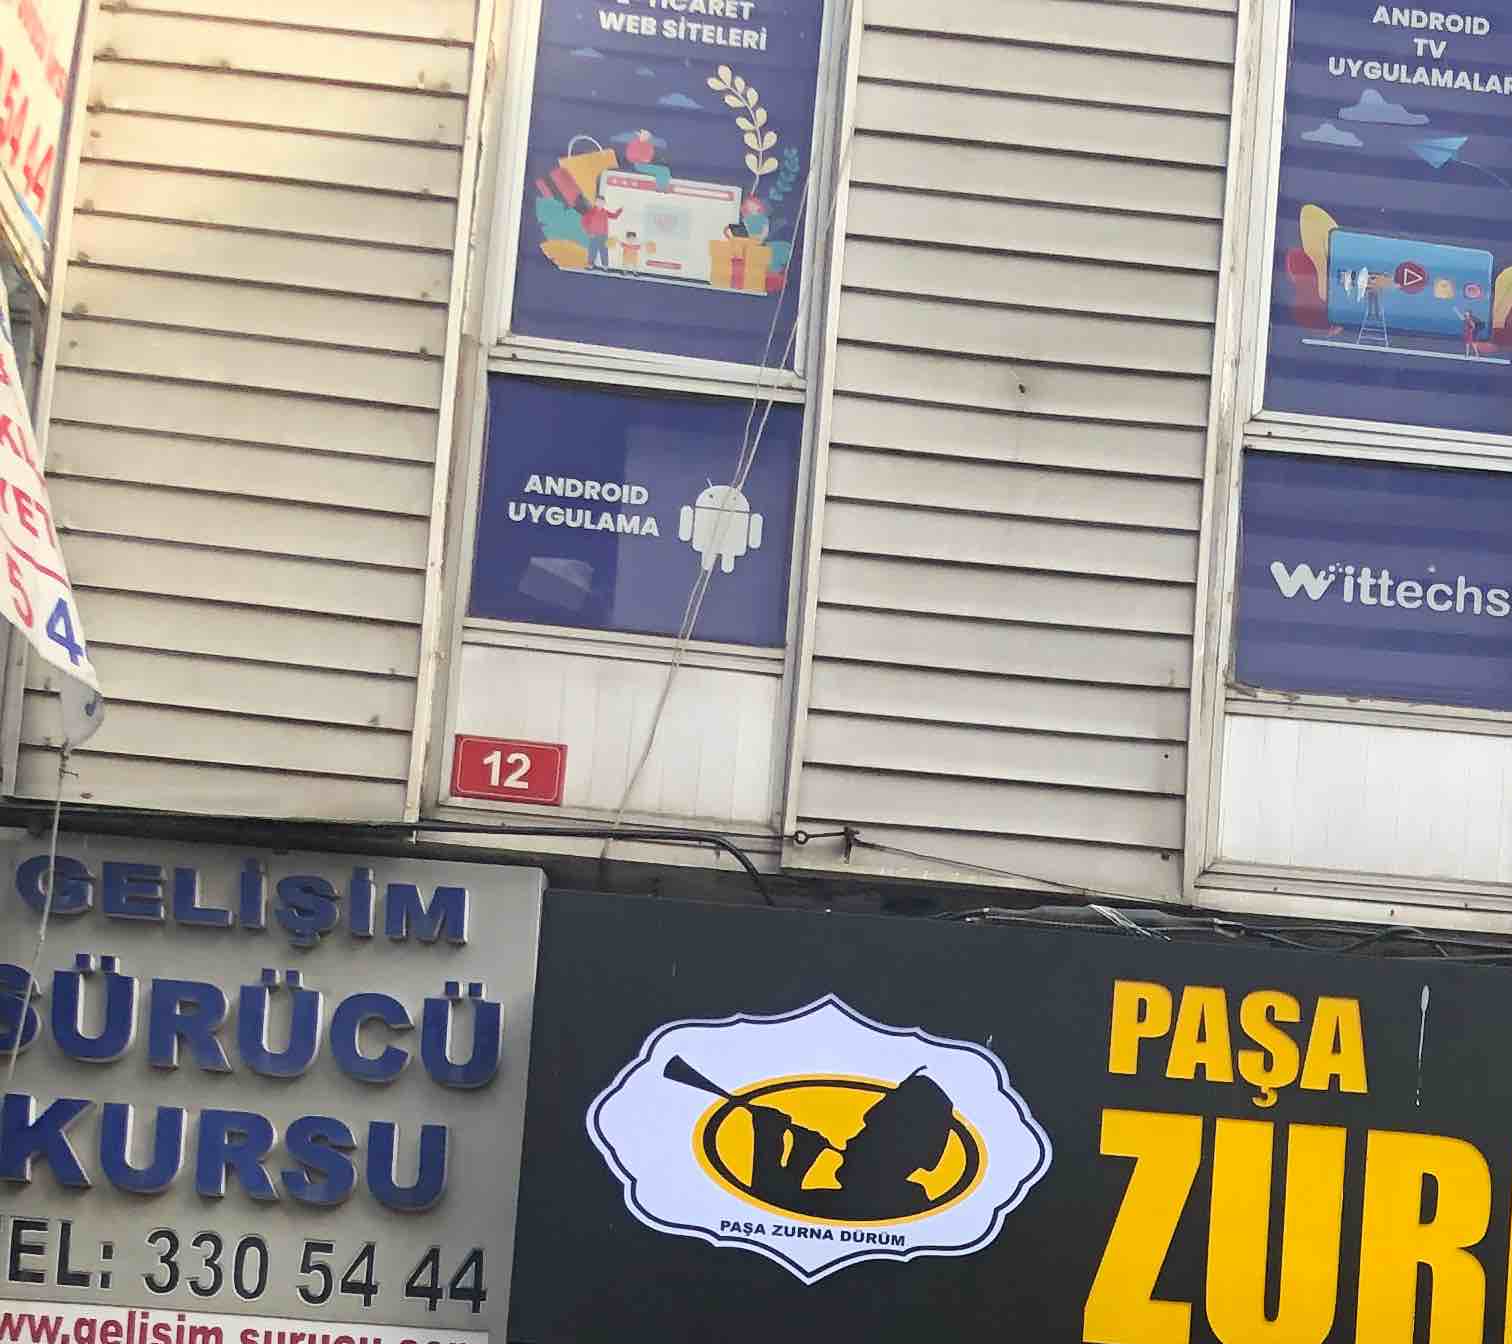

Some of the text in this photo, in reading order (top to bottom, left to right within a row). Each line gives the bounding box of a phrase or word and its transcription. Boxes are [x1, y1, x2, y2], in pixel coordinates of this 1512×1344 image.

[599, 11, 767, 50] WEB SİTELERİ
[1372, 5, 1491, 36] ANDROID
[1413, 37, 1446, 59] TV
[524, 474, 649, 506] ANDROID
[508, 501, 660, 538] UYGULAMA
[1270, 560, 1512, 617] Wittechs
[45, 597, 86, 667] 4
[481, 751, 532, 791] 12
[15, 854, 471, 947] GELİŞİM
[0, 951, 504, 1089] SÜRÜCÜ
[1108, 978, 1370, 1107] PAŞA
[0, 1093, 448, 1211] KURSU
[719, 1220, 907, 1248] PAŞA ZURNA DÜRÜM
[0, 1215, 487, 1313] EL: 330 54 44
